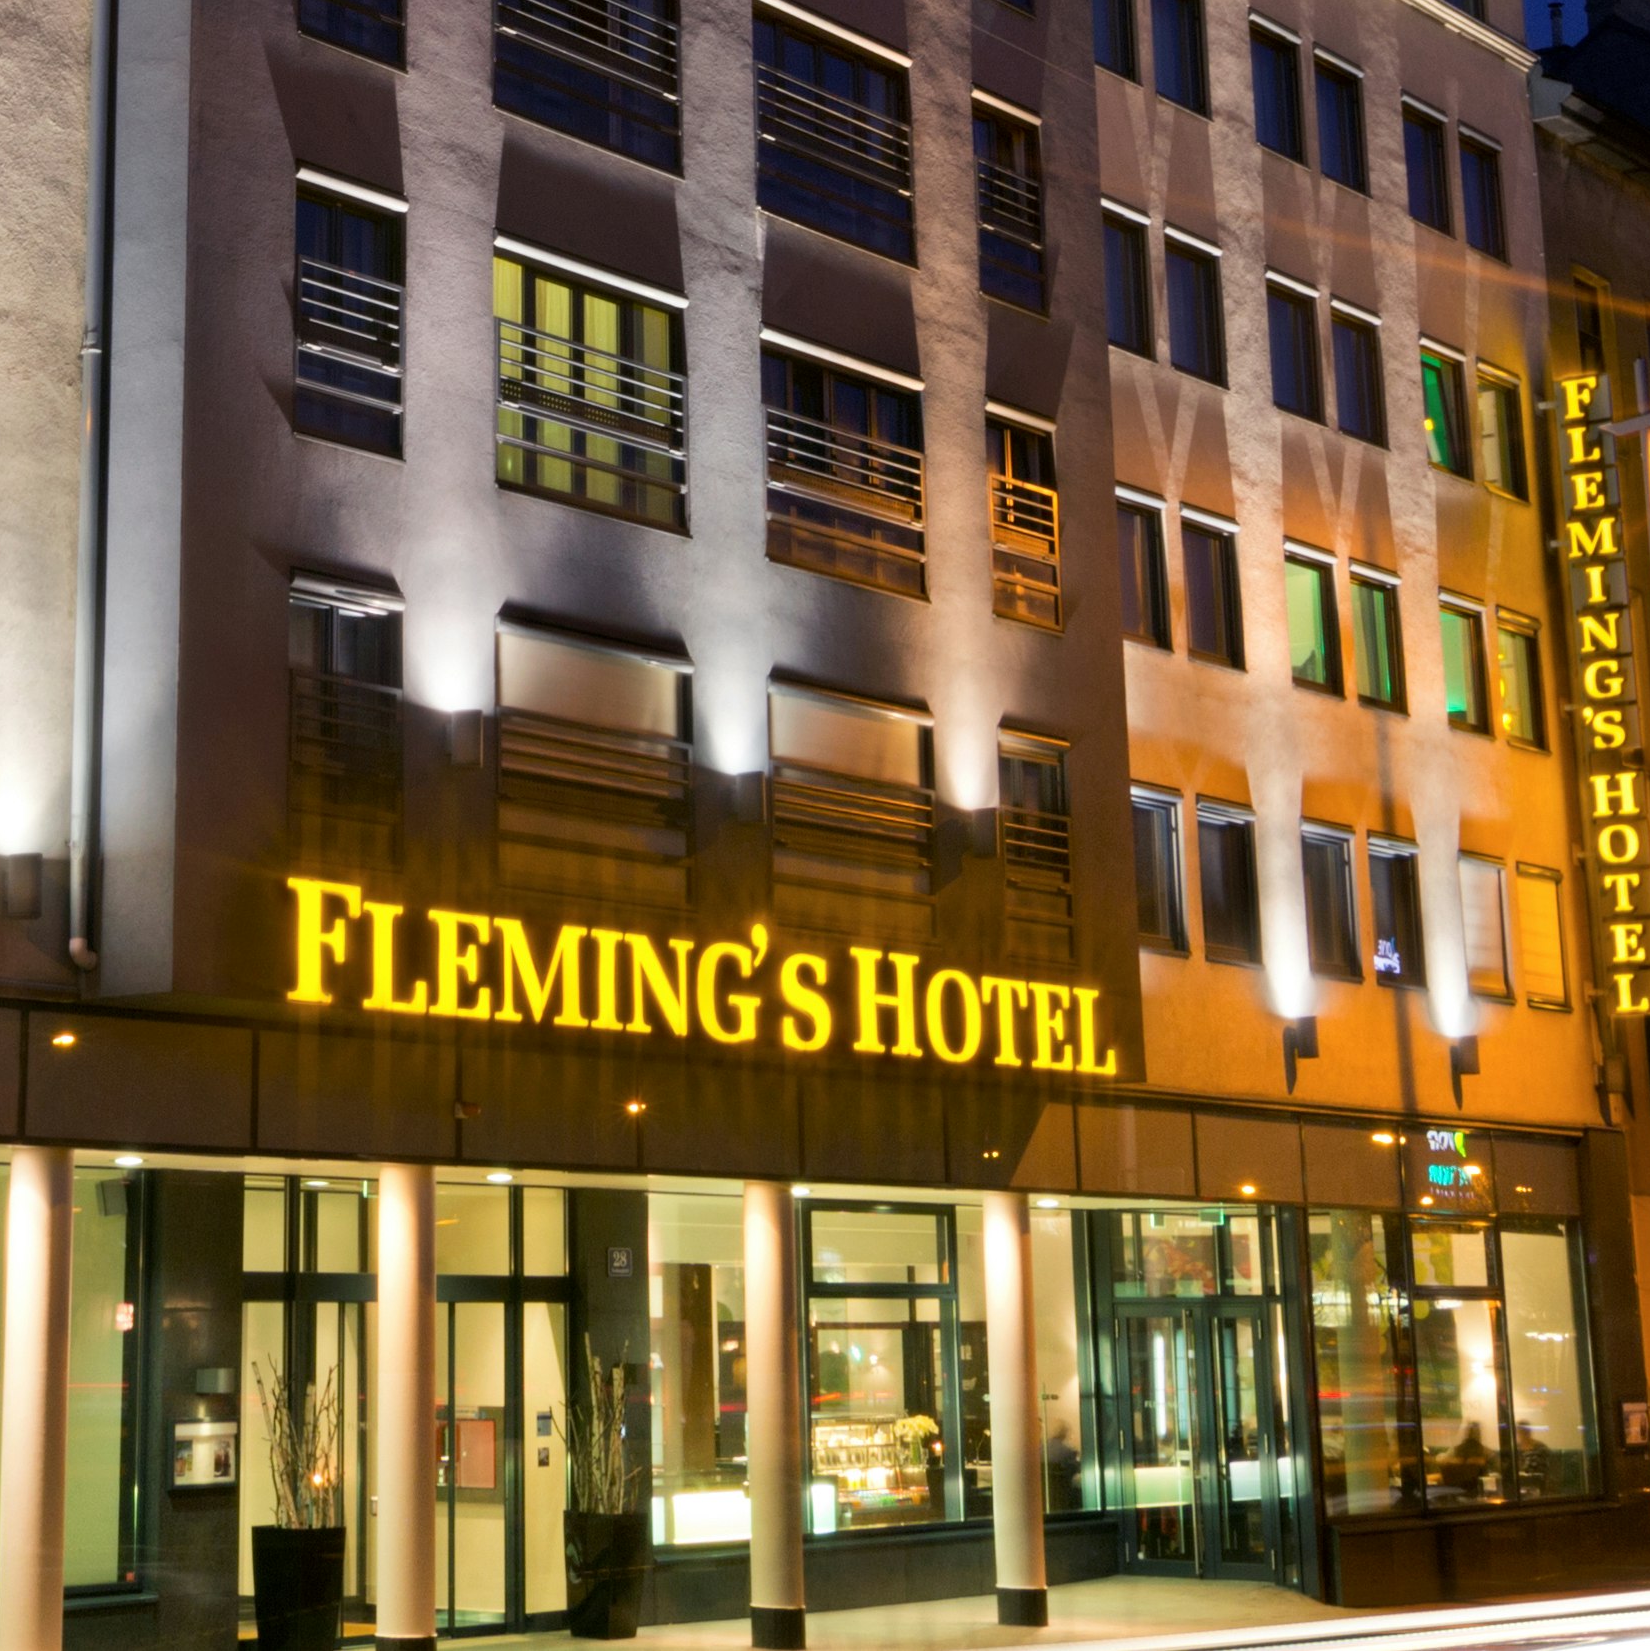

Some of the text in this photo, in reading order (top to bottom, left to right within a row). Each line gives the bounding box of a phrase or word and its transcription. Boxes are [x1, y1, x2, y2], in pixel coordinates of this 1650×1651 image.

[1561, 376, 1649, 1013] FLEMING'S HOTEL
[285, 876, 1117, 1076] FLEMING'S HOTEL
[612, 1251, 627, 1267] 28
